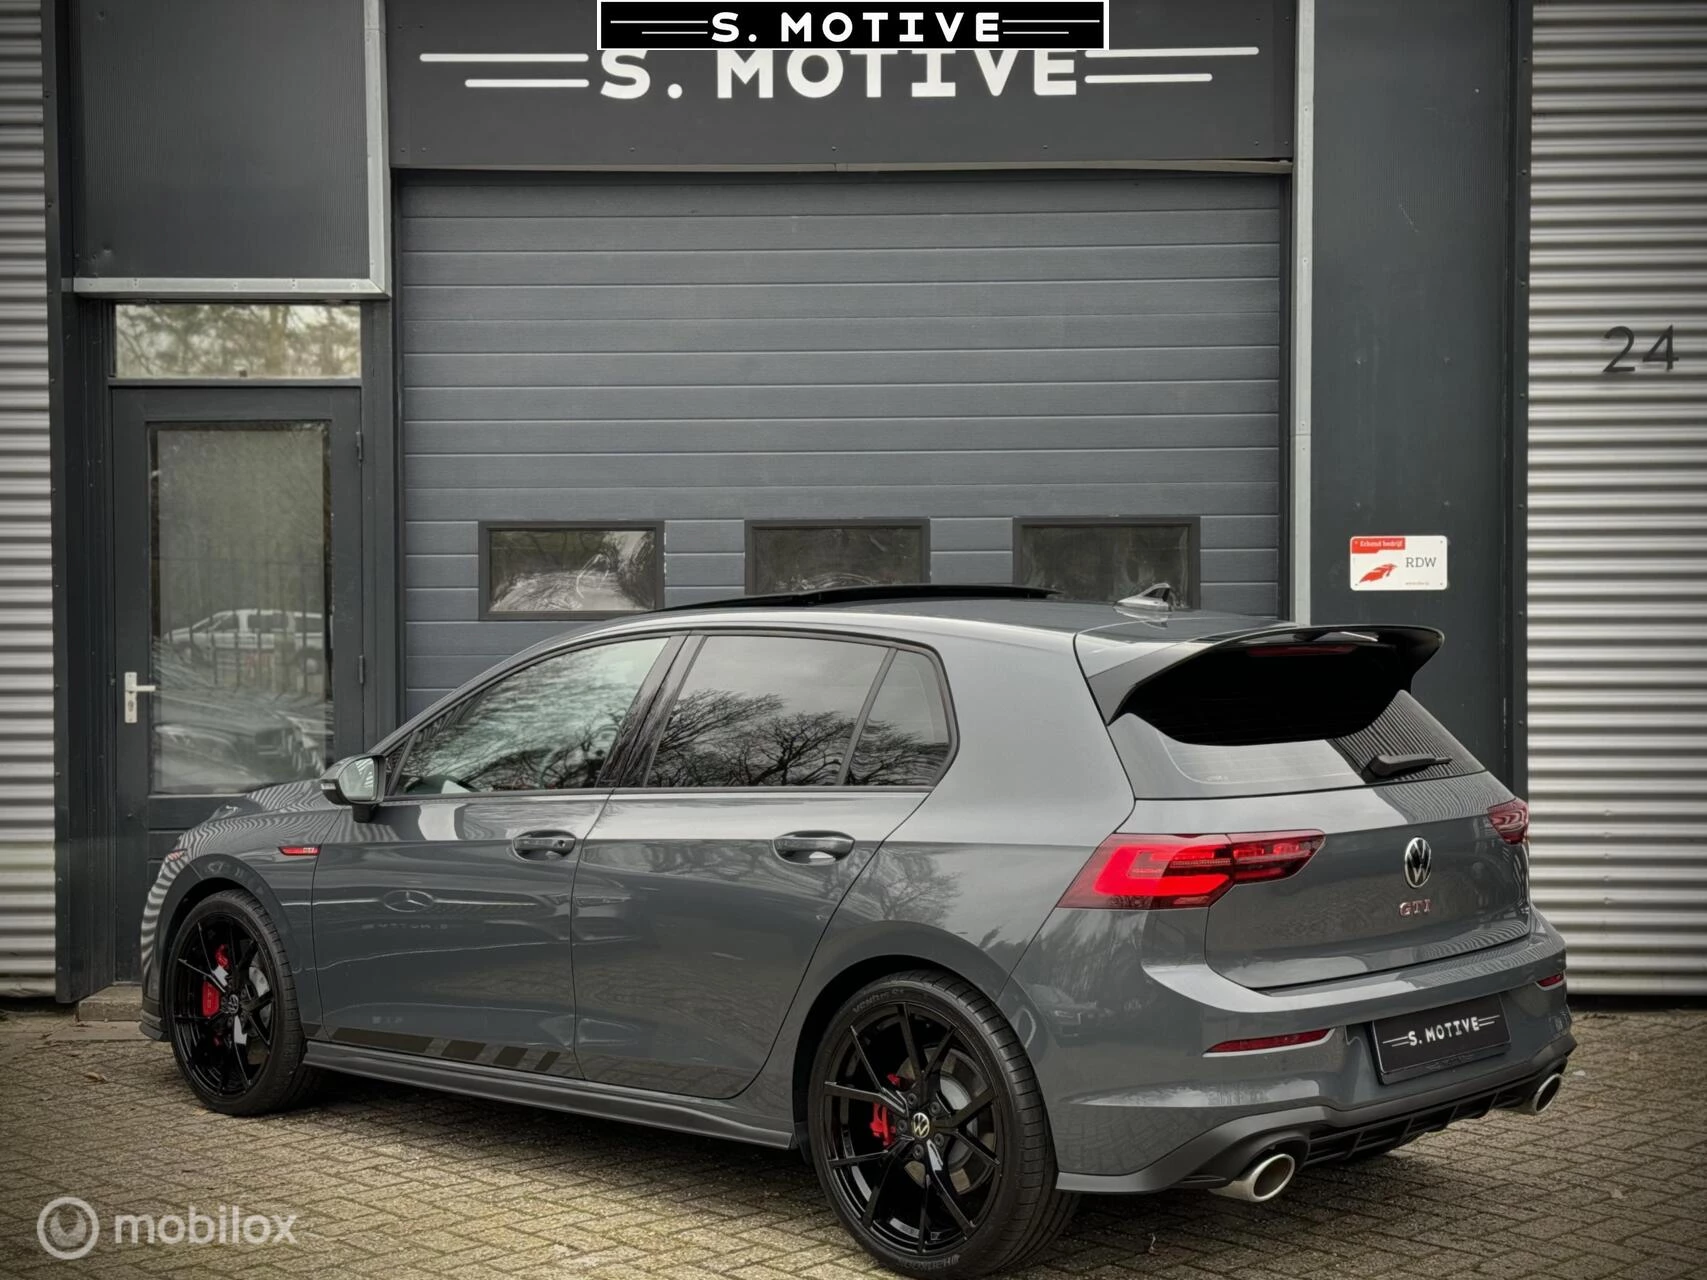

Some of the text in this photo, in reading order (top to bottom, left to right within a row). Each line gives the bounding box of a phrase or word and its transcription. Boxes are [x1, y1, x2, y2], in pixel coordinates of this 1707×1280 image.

[600, 50, 1077, 99] S. MOTIVE
[1603, 324, 1680, 373] 24
[1405, 557, 1437, 568] RDW
[1400, 899, 1431, 917] GTI
[1408, 1016, 1480, 1046] S. MOTIVE
